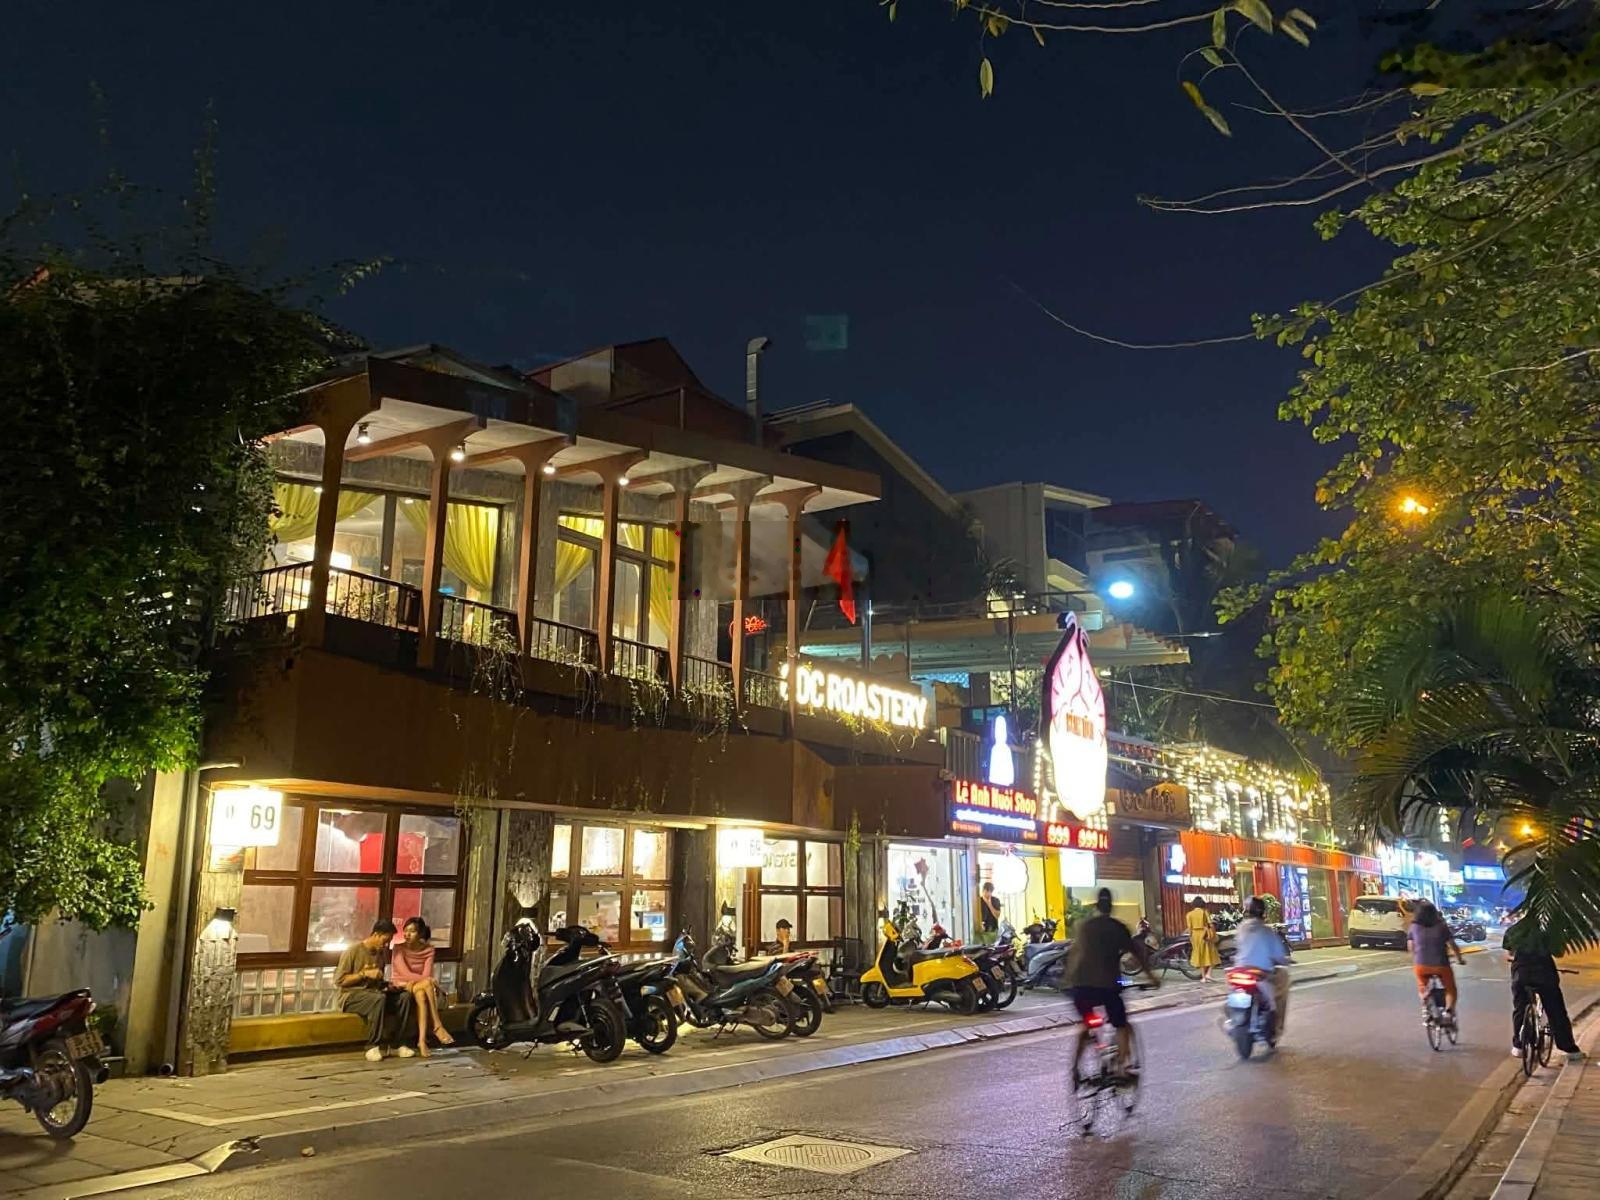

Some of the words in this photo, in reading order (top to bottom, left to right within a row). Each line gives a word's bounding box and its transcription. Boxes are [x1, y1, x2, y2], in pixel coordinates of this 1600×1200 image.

[826, 673, 928, 730] ROASTERY
[250, 804, 276, 830] 69
[956, 780, 969, 804] Lê
[970, 783, 990, 808] Anh
[1014, 792, 1037, 819] Shop
